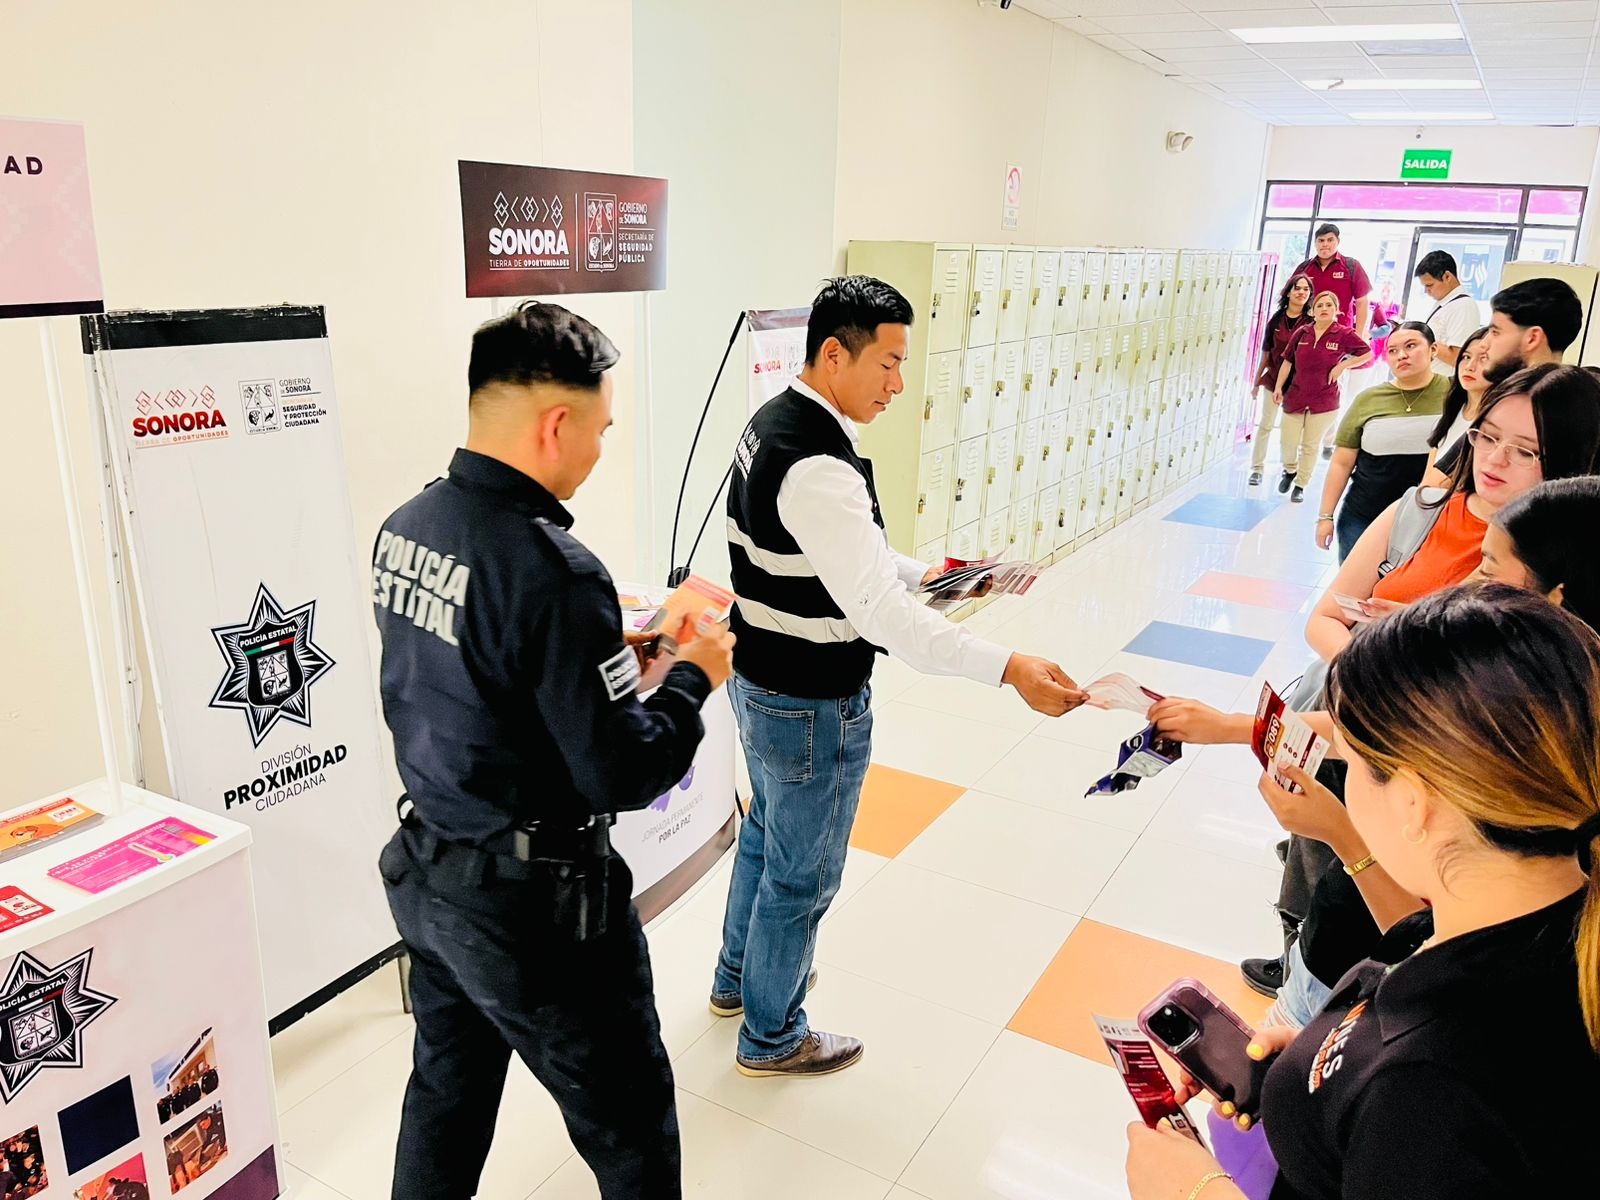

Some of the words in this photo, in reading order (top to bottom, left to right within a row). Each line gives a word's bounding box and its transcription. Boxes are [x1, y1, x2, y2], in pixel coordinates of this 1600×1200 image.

[1404, 159, 1448, 169] SALIDA
[618, 202, 648, 214] GOBIERNO
[624, 214, 648, 225] SONORA
[488, 227, 570, 256] SONORA
[618, 232, 647, 241] SECRETARÍA
[648, 233, 655, 241] DE
[618, 242, 653, 252] SEGURIDAD
[618, 251, 646, 263] PÚBLICA
[489, 259, 512, 268] TIERRA
[523, 259, 570, 267] OPORTUNIDADES
[279, 377, 311, 388] GOBIERNO
[285, 384, 312, 394] SONORA
[282, 403, 317, 413] SEGURIDAD
[283, 413, 289, 421] Y
[289, 408, 327, 420] PROTECCIÓN
[132, 409, 227, 438] SONORA
[284, 418, 320, 428] CIUDADANA
[172, 430, 229, 442] OPORTUNIDADES
[374, 530, 471, 607] POLICÍA
[240, 633, 268, 648] POLICÍA
[267, 625, 297, 640] ESTATAL
[261, 743, 313, 774] DIVISIÓN
[223, 744, 348, 811] PROXIMIDAD
[255, 773, 327, 812] CIUDADANA
[28, 978, 67, 1000] ESTATAL
